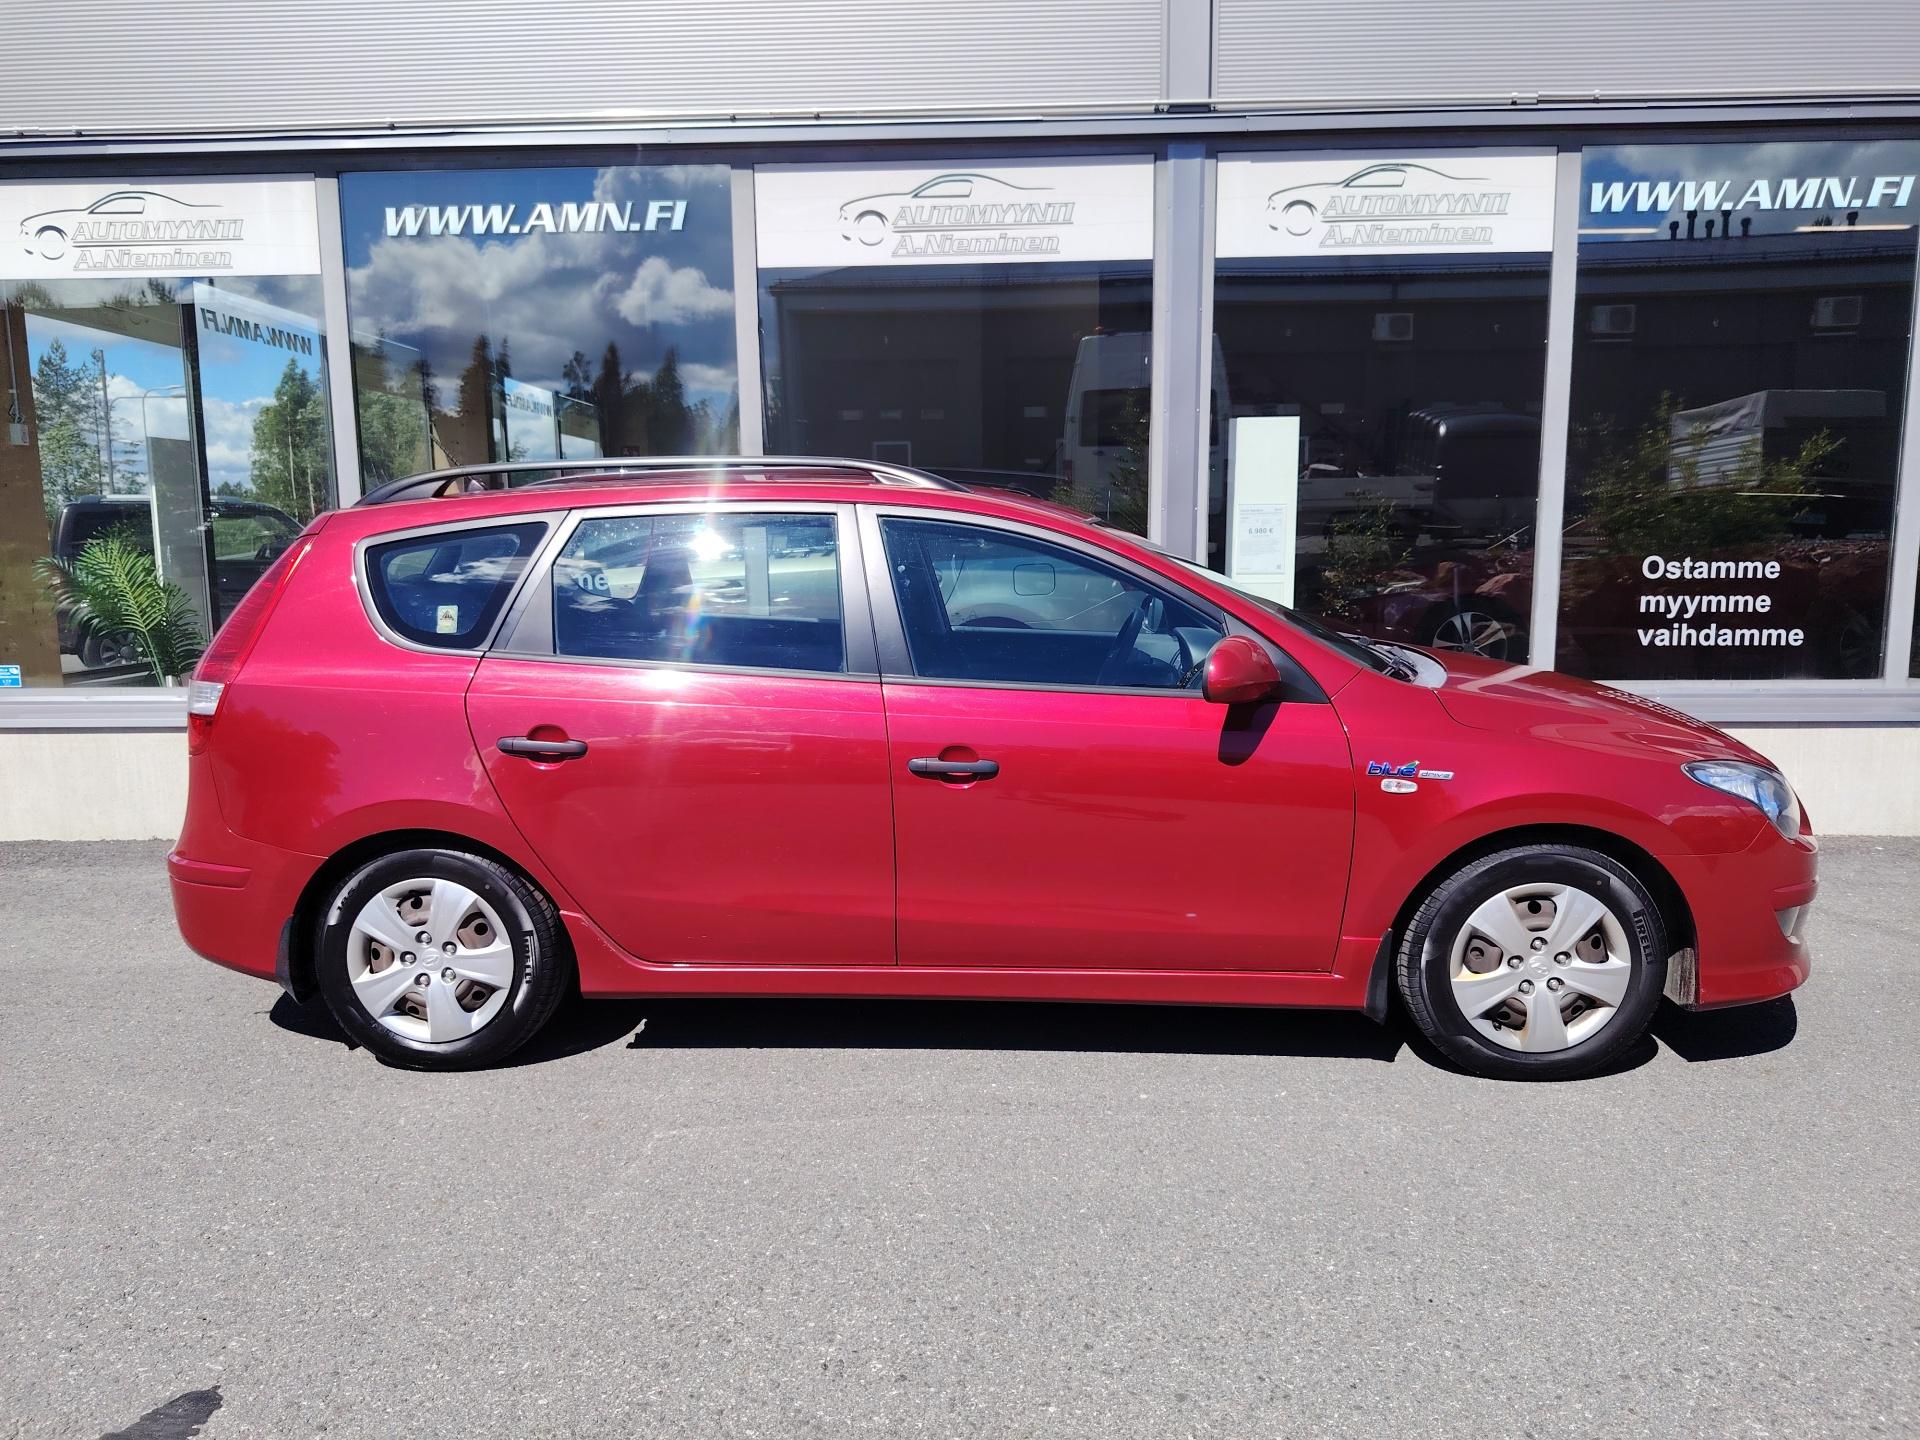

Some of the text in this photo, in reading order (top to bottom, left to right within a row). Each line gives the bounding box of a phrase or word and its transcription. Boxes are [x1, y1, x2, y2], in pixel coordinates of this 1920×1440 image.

[1321, 192, 1511, 216] AUTOMYYNTI
[1590, 175, 1917, 213] WWW.AMN.FI
[385, 200, 688, 236] WWW.AMN.FI
[892, 202, 1076, 226] AUTOMYYNTI
[72, 219, 244, 241] AUTOMYYNTI
[1321, 223, 1493, 246] A.Nieminen
[893, 232, 1061, 256] A.Nieminen
[74, 248, 232, 269] A.Nieminen
[1642, 555, 1781, 579] Ostamme
[1639, 593, 1772, 619] myymme
[1637, 623, 1805, 647] vaihdamme
[1366, 760, 1451, 779] blue drive
